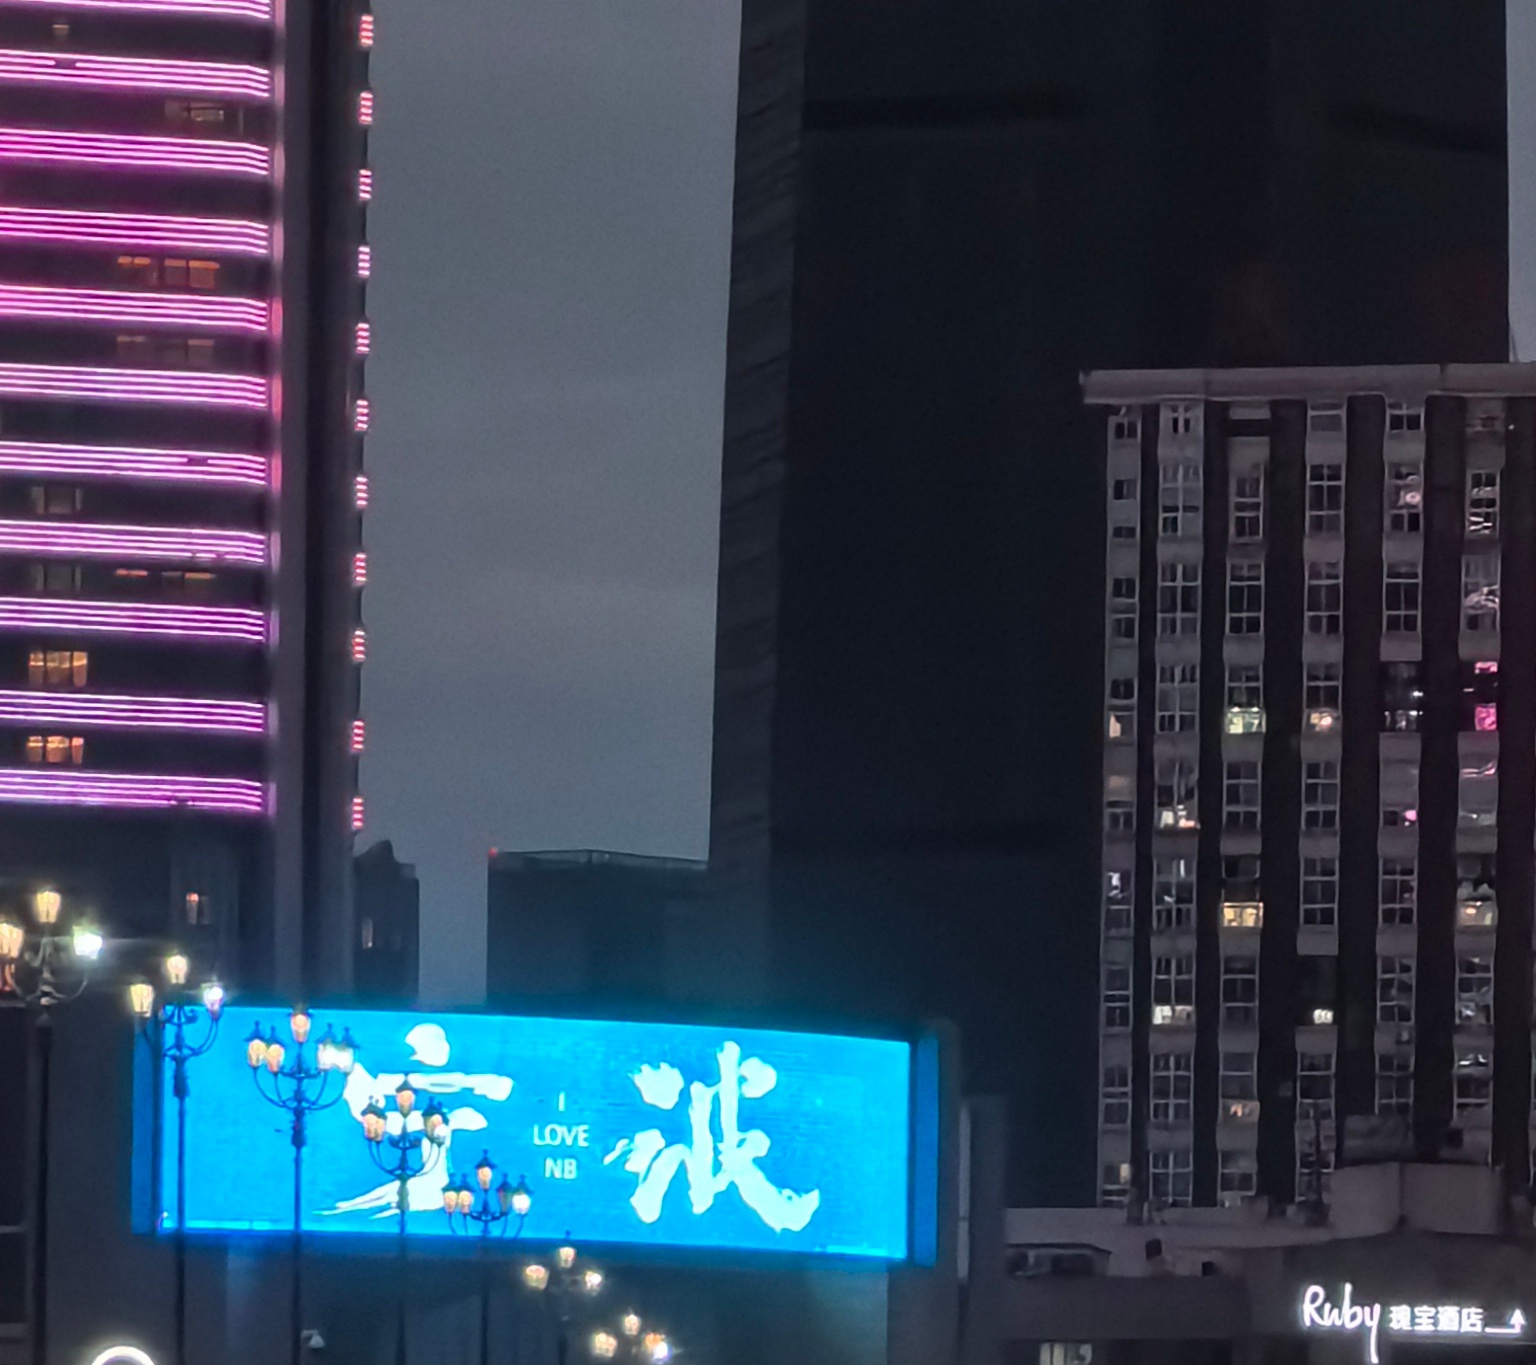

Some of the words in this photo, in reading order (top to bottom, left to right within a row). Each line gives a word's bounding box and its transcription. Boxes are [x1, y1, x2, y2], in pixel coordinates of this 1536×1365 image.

[557, 1090, 567, 1113] I
[533, 1123, 590, 1148] LOVE
[544, 1157, 578, 1180] NB
[1303, 1282, 1381, 1364] Ruby
